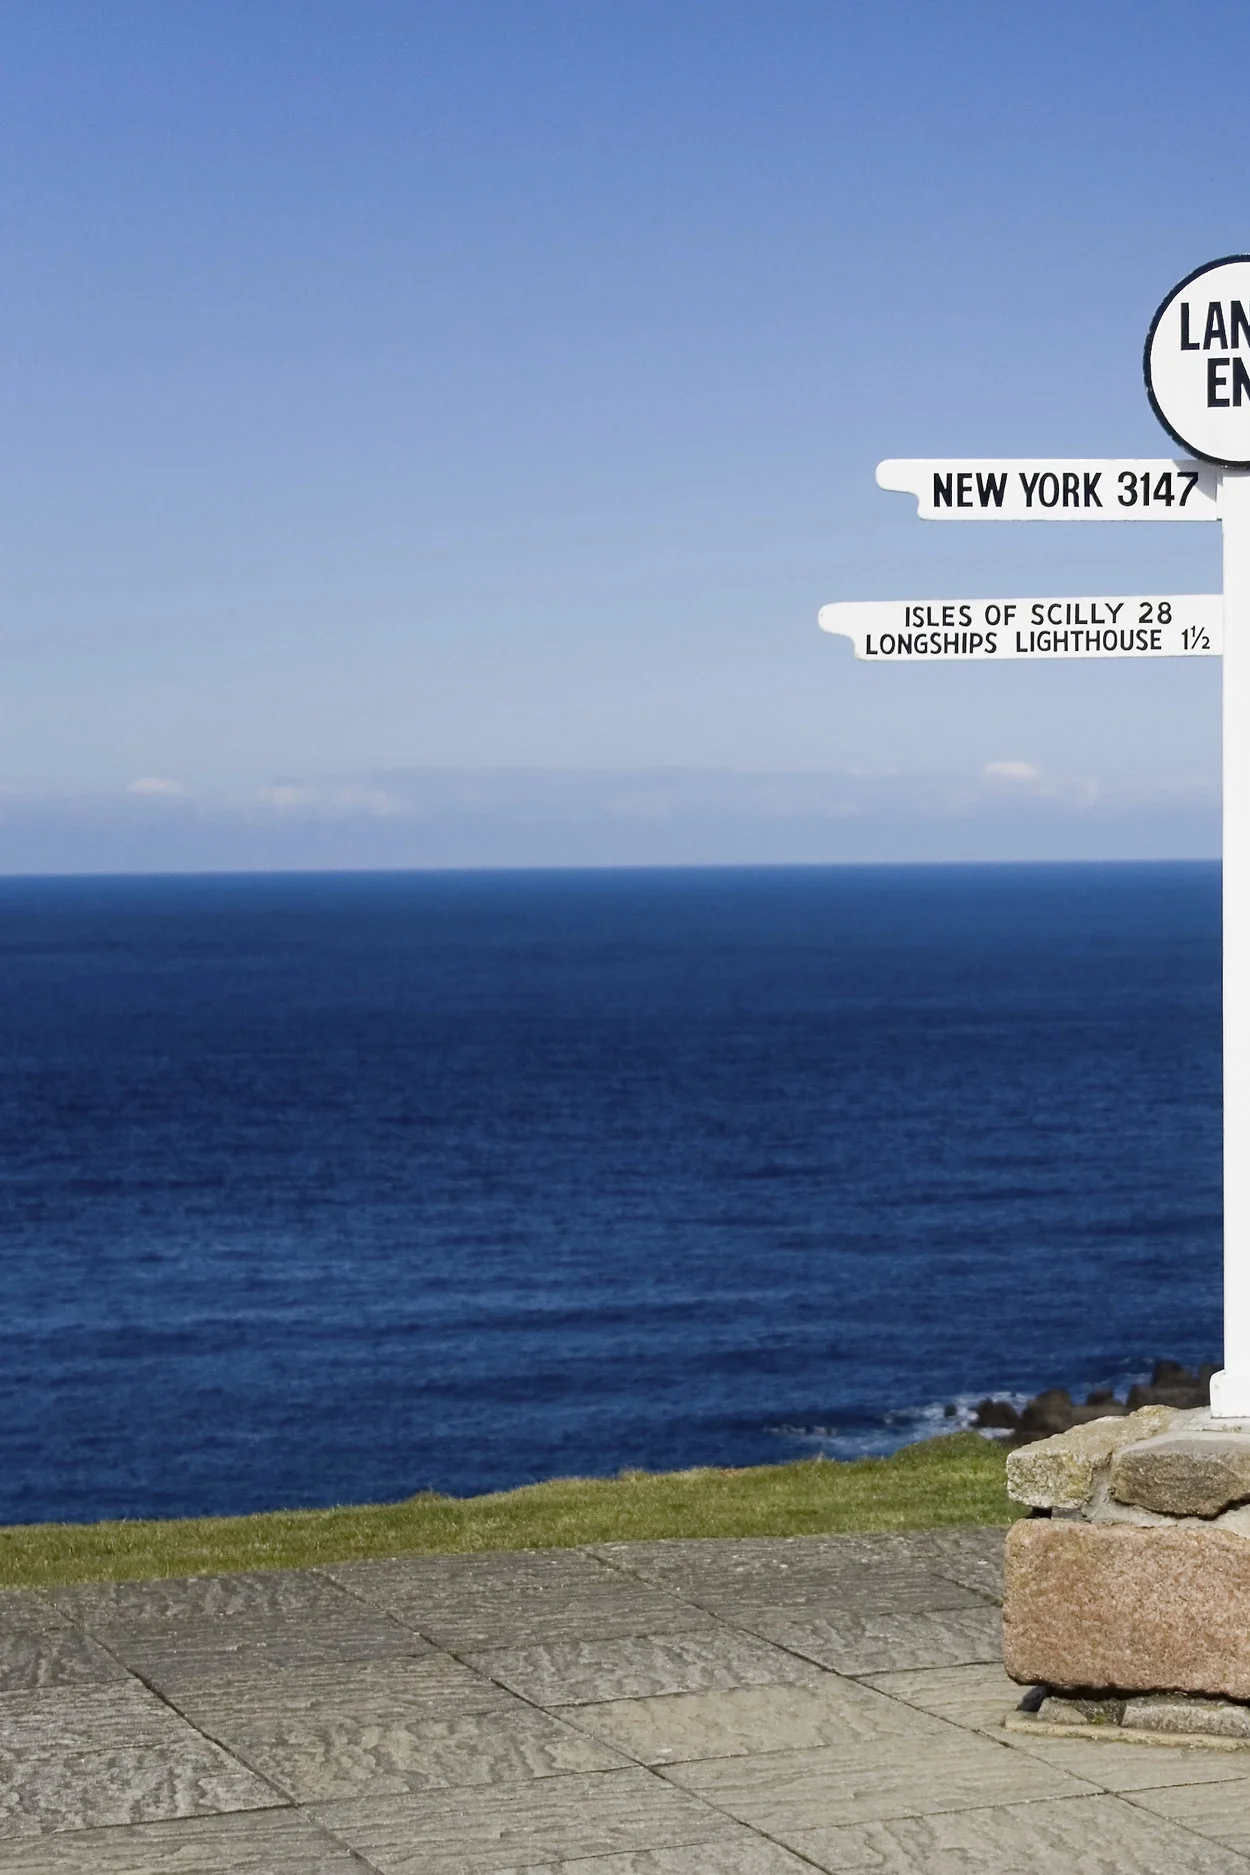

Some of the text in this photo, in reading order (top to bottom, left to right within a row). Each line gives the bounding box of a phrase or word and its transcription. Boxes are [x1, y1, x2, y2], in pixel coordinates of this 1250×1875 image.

[932, 470, 1199, 508] NEW YORK 3147
[904, 601, 1174, 629] ISLES OF SCILLY 28
[865, 631, 998, 656] LONGSHIPS
[1015, 628, 1163, 653] LIGHTHOUSE
